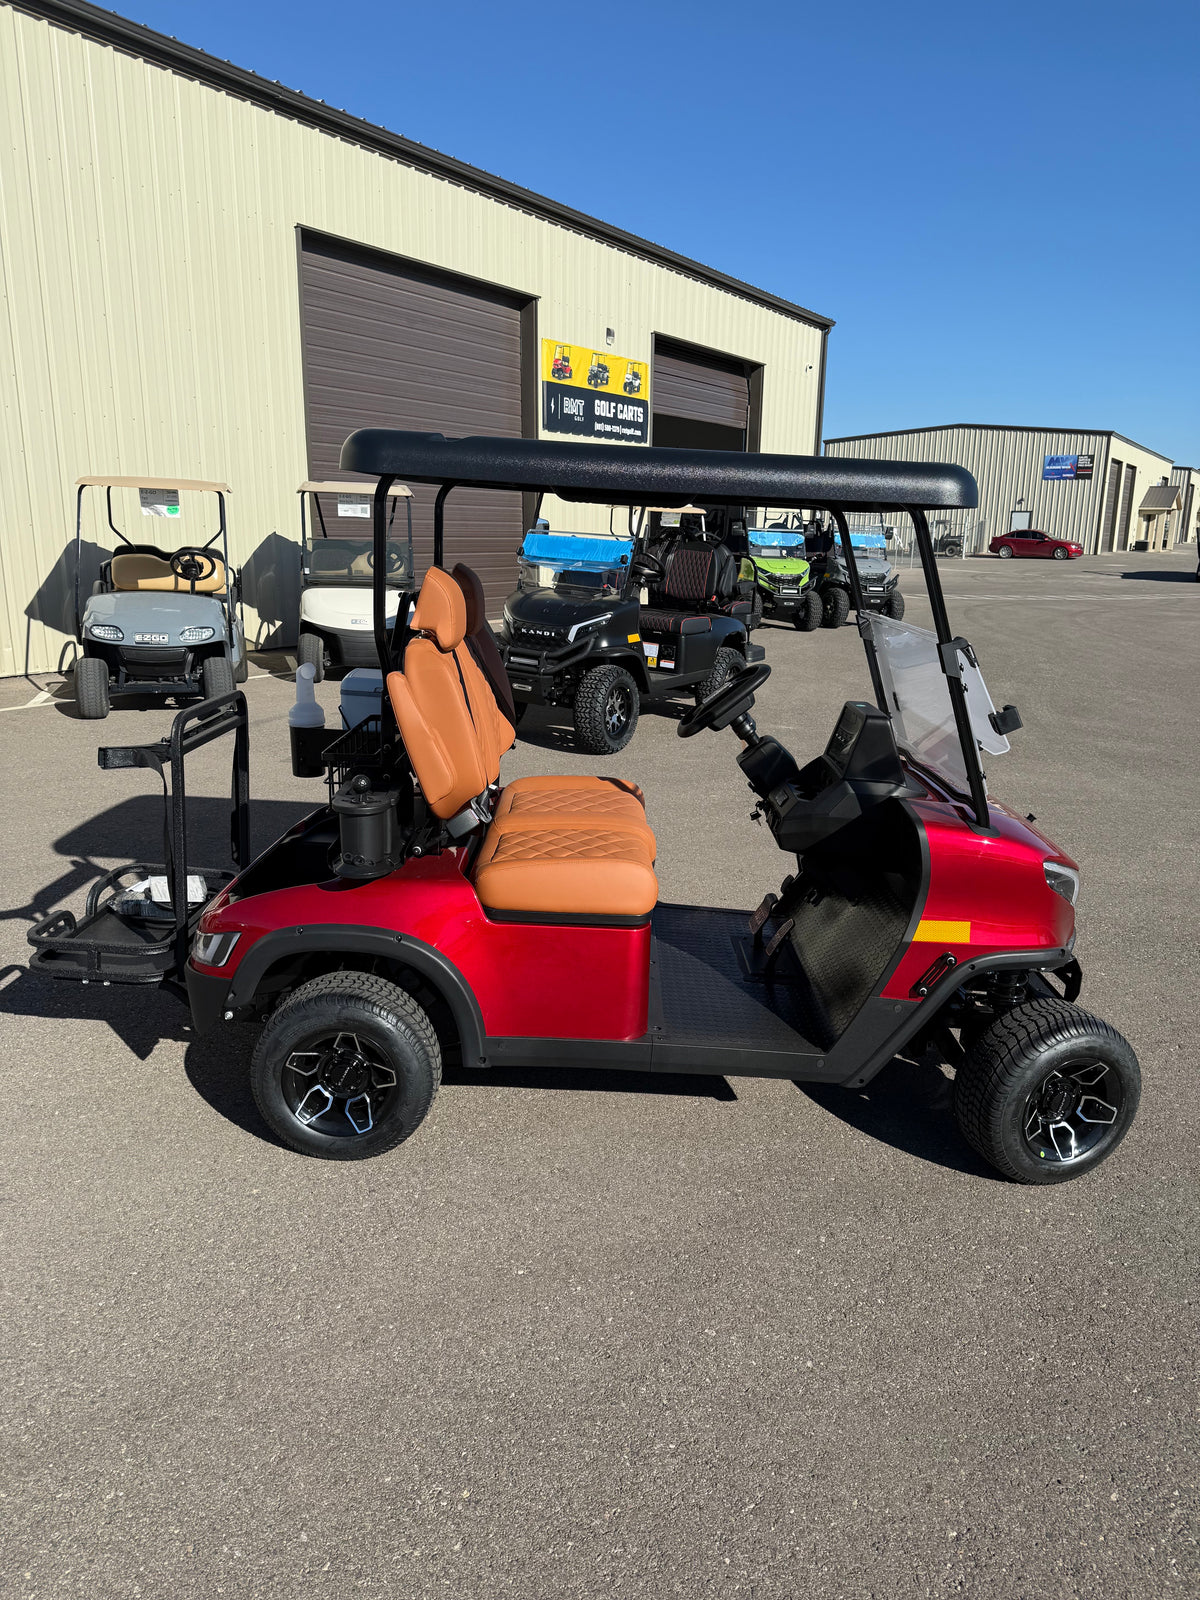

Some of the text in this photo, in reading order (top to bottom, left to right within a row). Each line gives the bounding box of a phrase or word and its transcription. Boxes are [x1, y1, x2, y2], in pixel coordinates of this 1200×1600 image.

[594, 399, 644, 423] GOLF CARTS
[521, 628, 555, 637] KANDI
